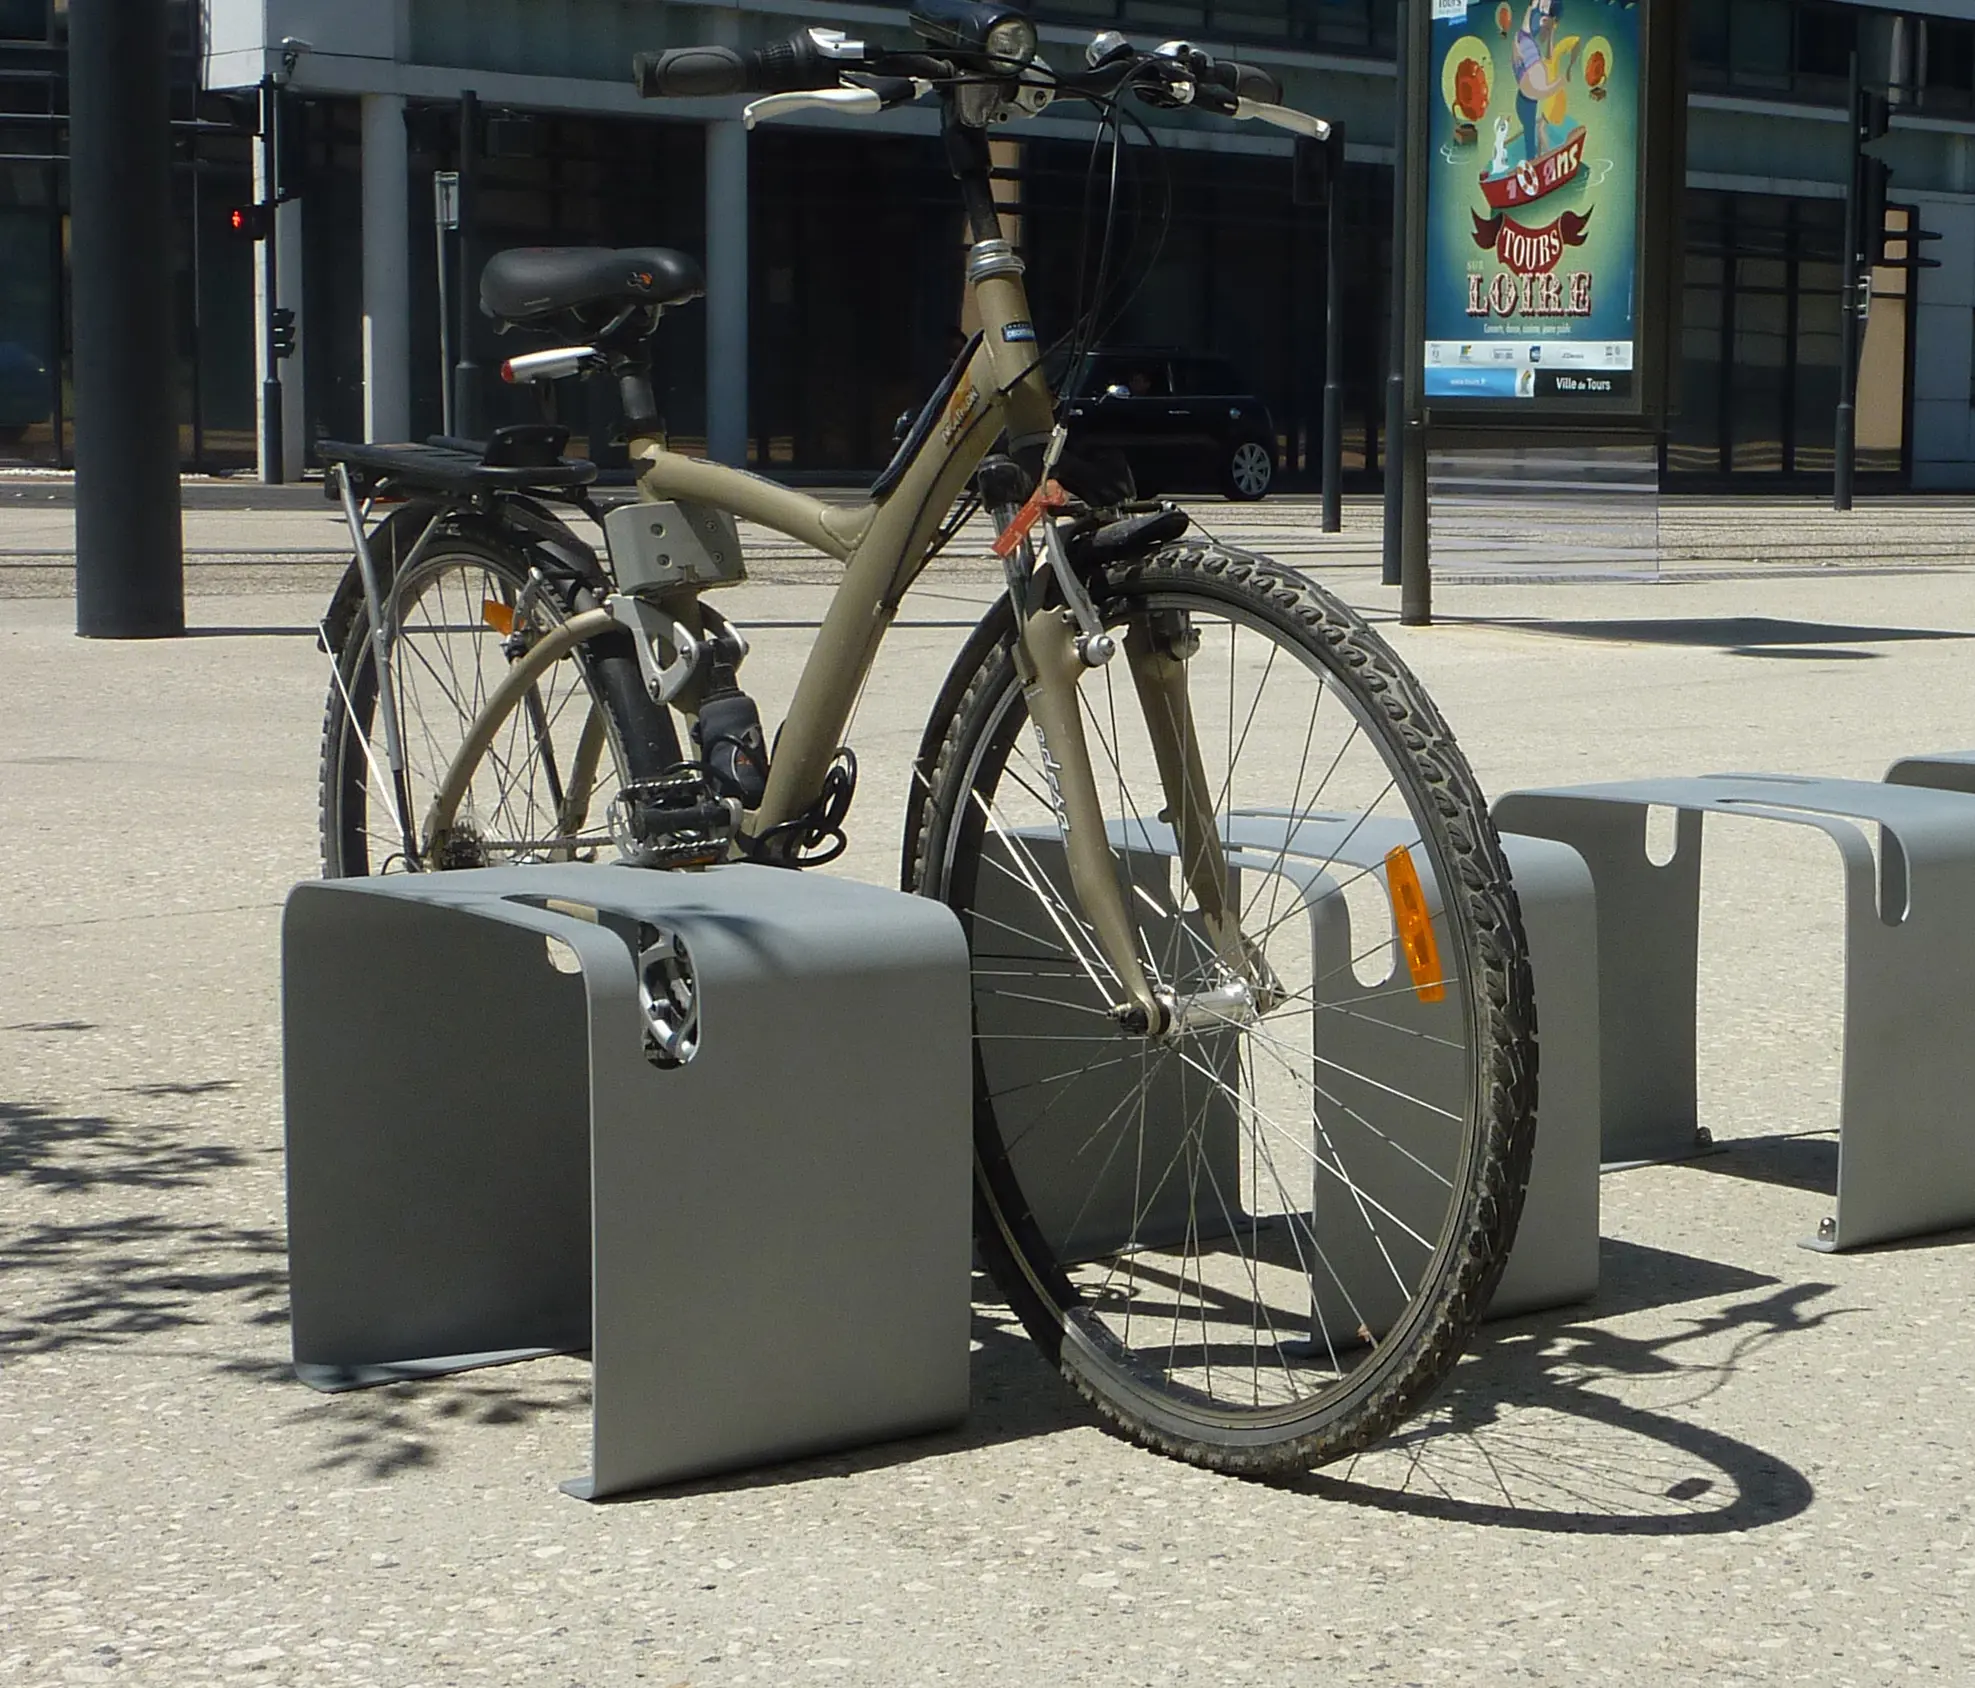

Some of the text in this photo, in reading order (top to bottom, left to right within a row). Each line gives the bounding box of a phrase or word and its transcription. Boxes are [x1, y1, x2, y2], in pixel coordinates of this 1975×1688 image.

[1502, 226, 1560, 270] TOURS
[1465, 271, 1593, 317] LOIRE
[1556, 376, 1611, 391] Ville de Tours
